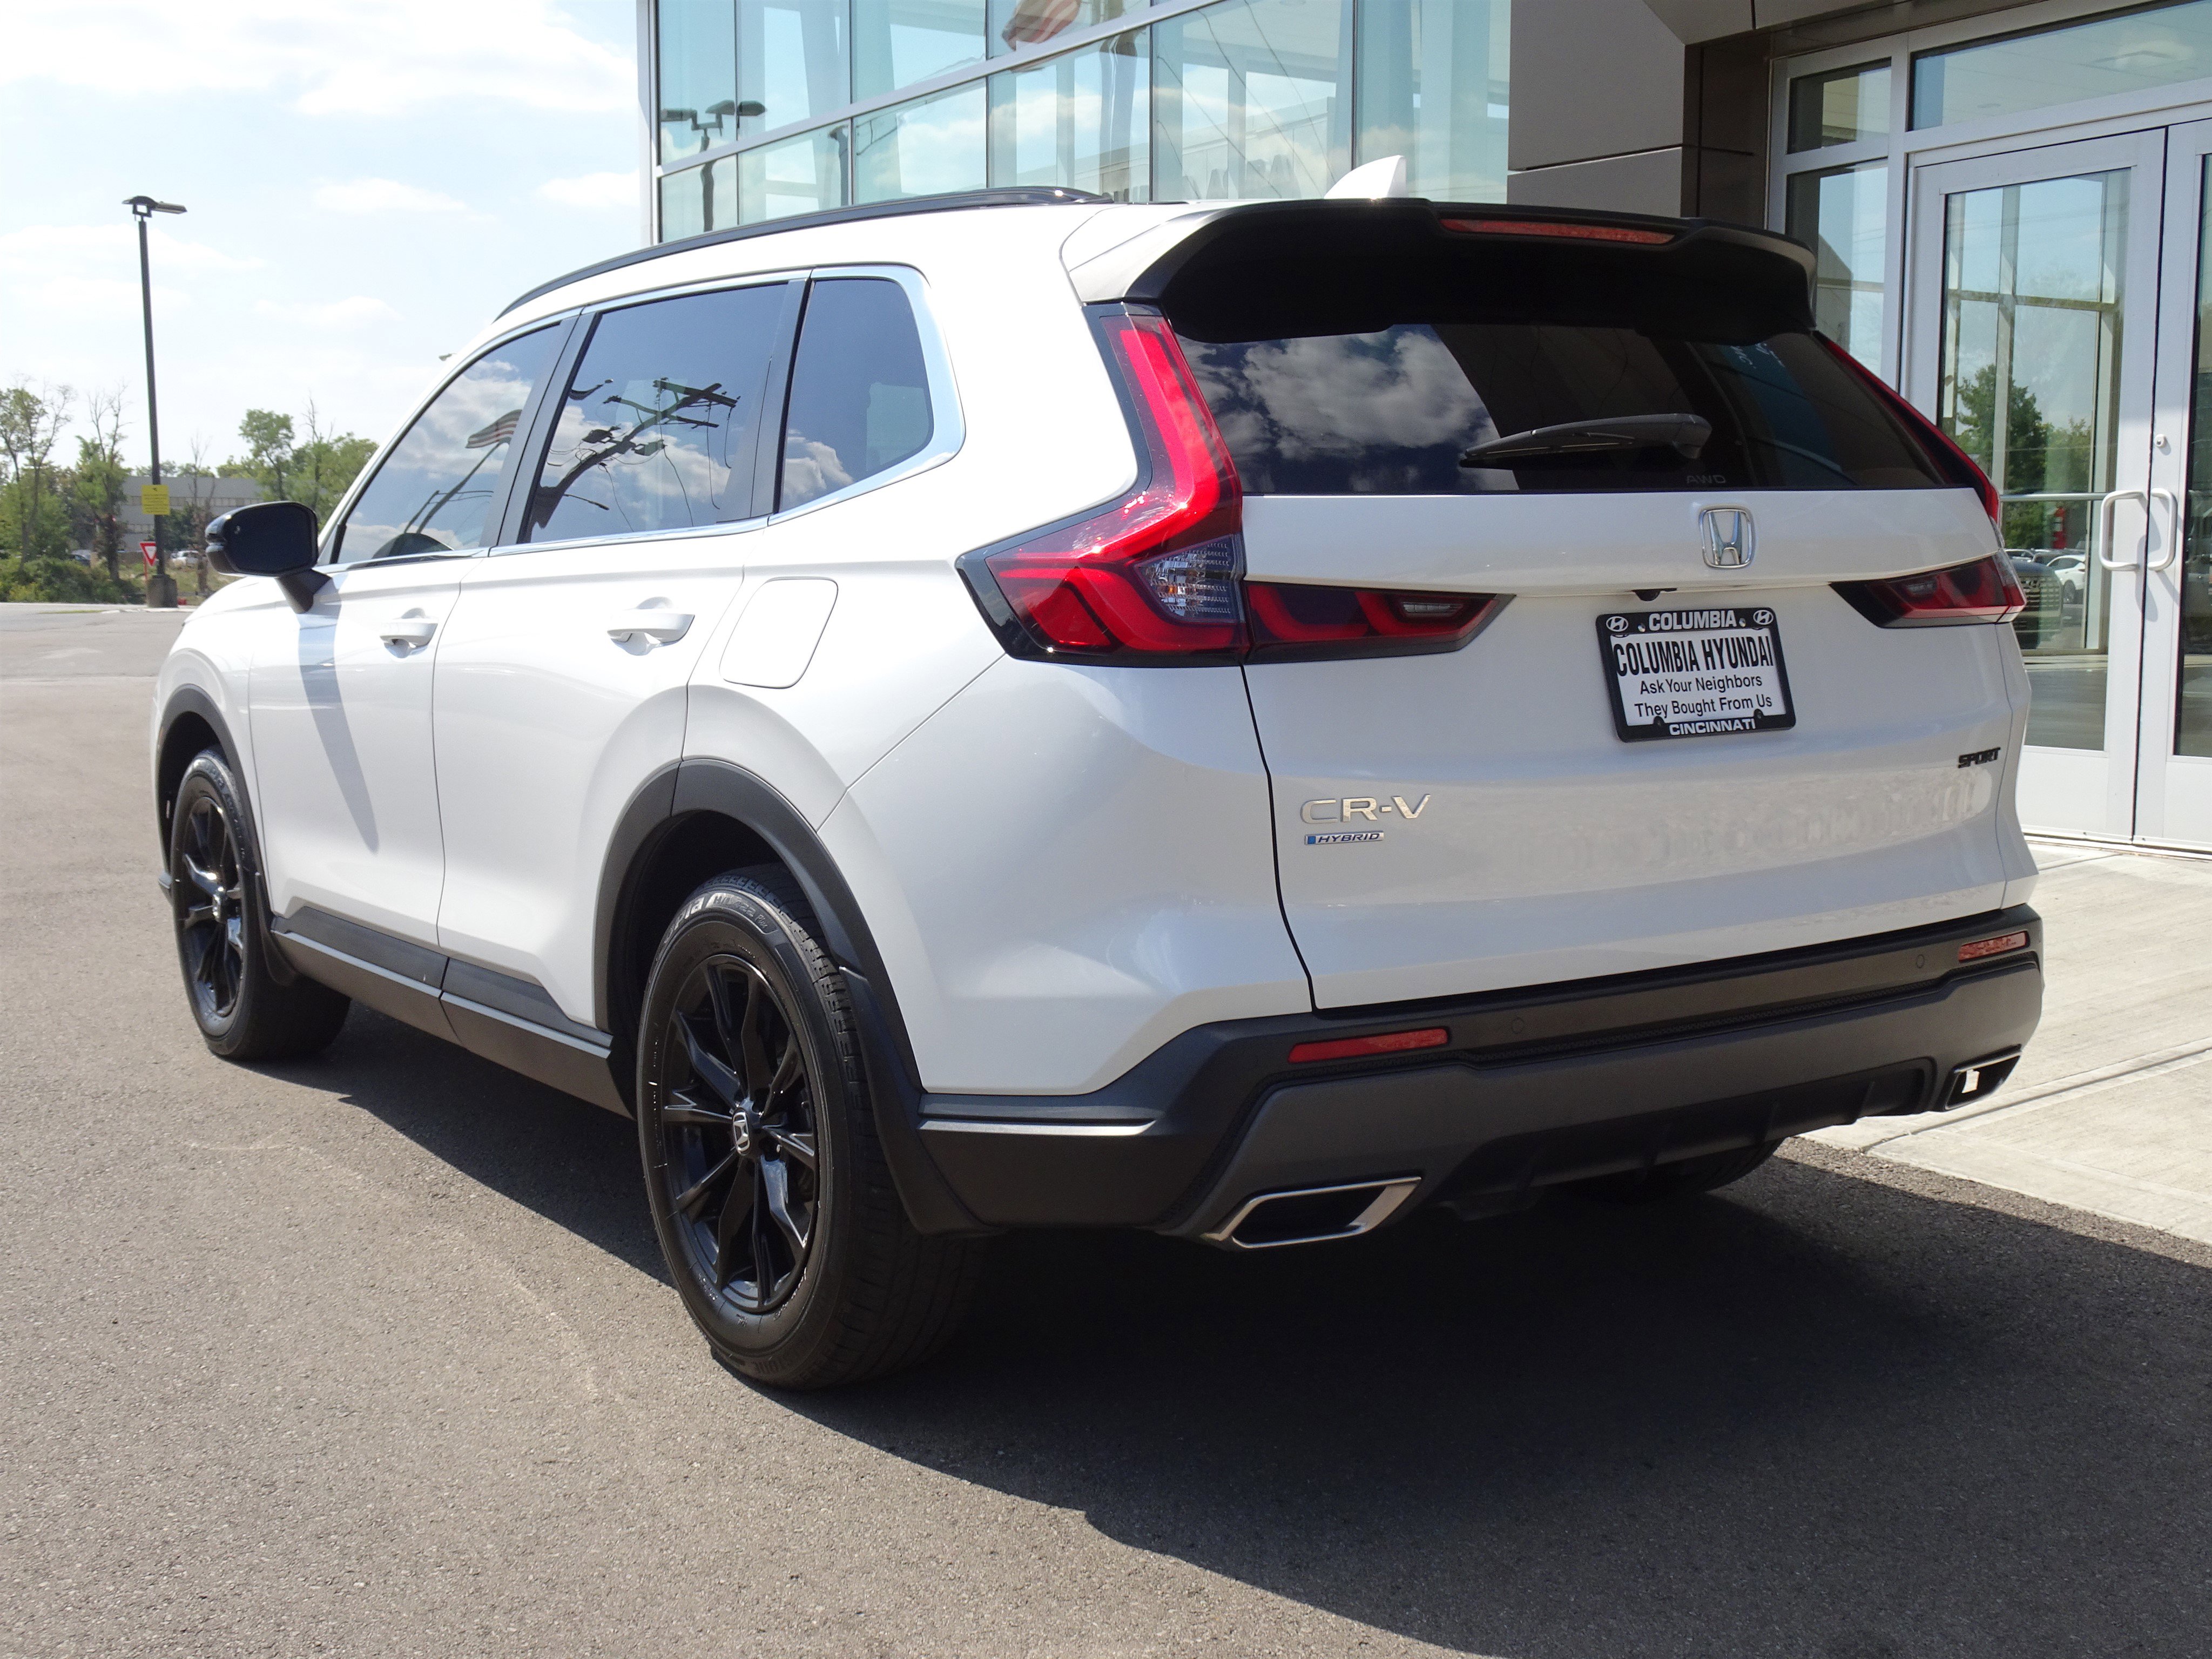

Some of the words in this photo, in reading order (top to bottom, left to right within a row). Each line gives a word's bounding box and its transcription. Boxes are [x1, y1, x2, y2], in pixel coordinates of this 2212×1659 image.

[1687, 475, 1726, 484] AWD
[1649, 610, 1737, 631] COLUMBIA
[1613, 640, 1700, 677] COLUMBIA
[1701, 636, 1774, 670] HYUNDAI
[1640, 679, 1665, 694] Ask
[1665, 679, 1691, 693] Your
[1695, 675, 1763, 693] Neighbors
[1635, 704, 1668, 718] They
[1671, 700, 1715, 717] Bought
[1719, 697, 1754, 711] From
[1756, 694, 1772, 707] Us
[1669, 718, 1756, 736] CINCINNATI
[1958, 747, 2001, 768] SPORT
[1300, 794, 1431, 824] CR-V
[1318, 833, 1380, 843] HYBRID
